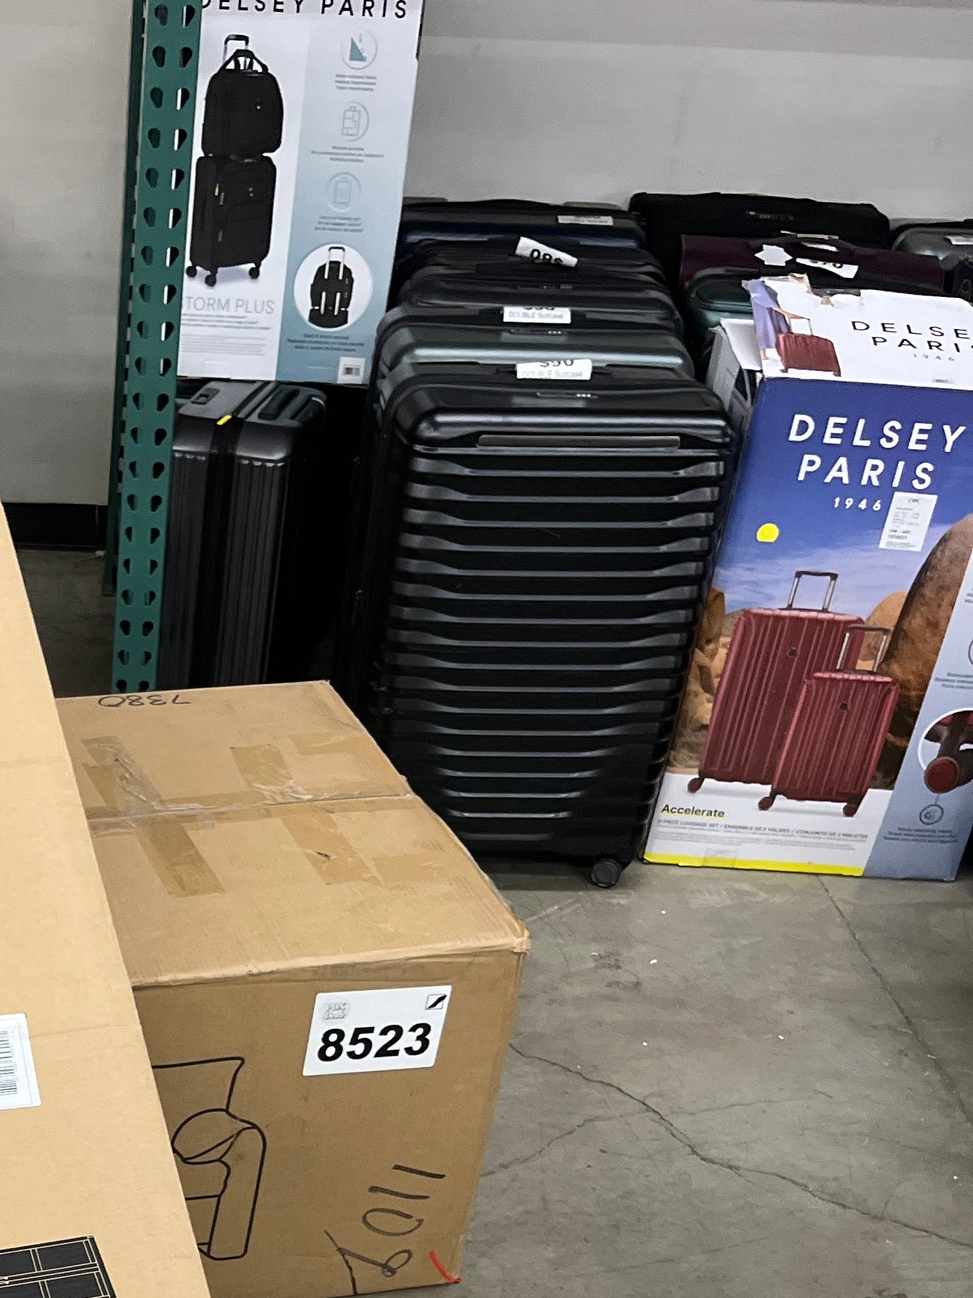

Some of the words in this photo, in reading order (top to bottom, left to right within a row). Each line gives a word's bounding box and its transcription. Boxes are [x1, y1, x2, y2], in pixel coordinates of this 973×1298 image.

[202, 0, 303, 13] ELSEY
[321, 0, 407, 19] PARIS
[185, 296, 230, 312] TORM
[235, 298, 275, 315] PLUS
[851, 320, 971, 340] DELSE
[871, 336, 973, 353] PARI
[788, 413, 966, 452] DELSEY
[797, 454, 935, 490] PARIS
[833, 497, 881, 511] 1946
[661, 804, 725, 818] Accelerate
[317, 1023, 432, 1062] 8523
